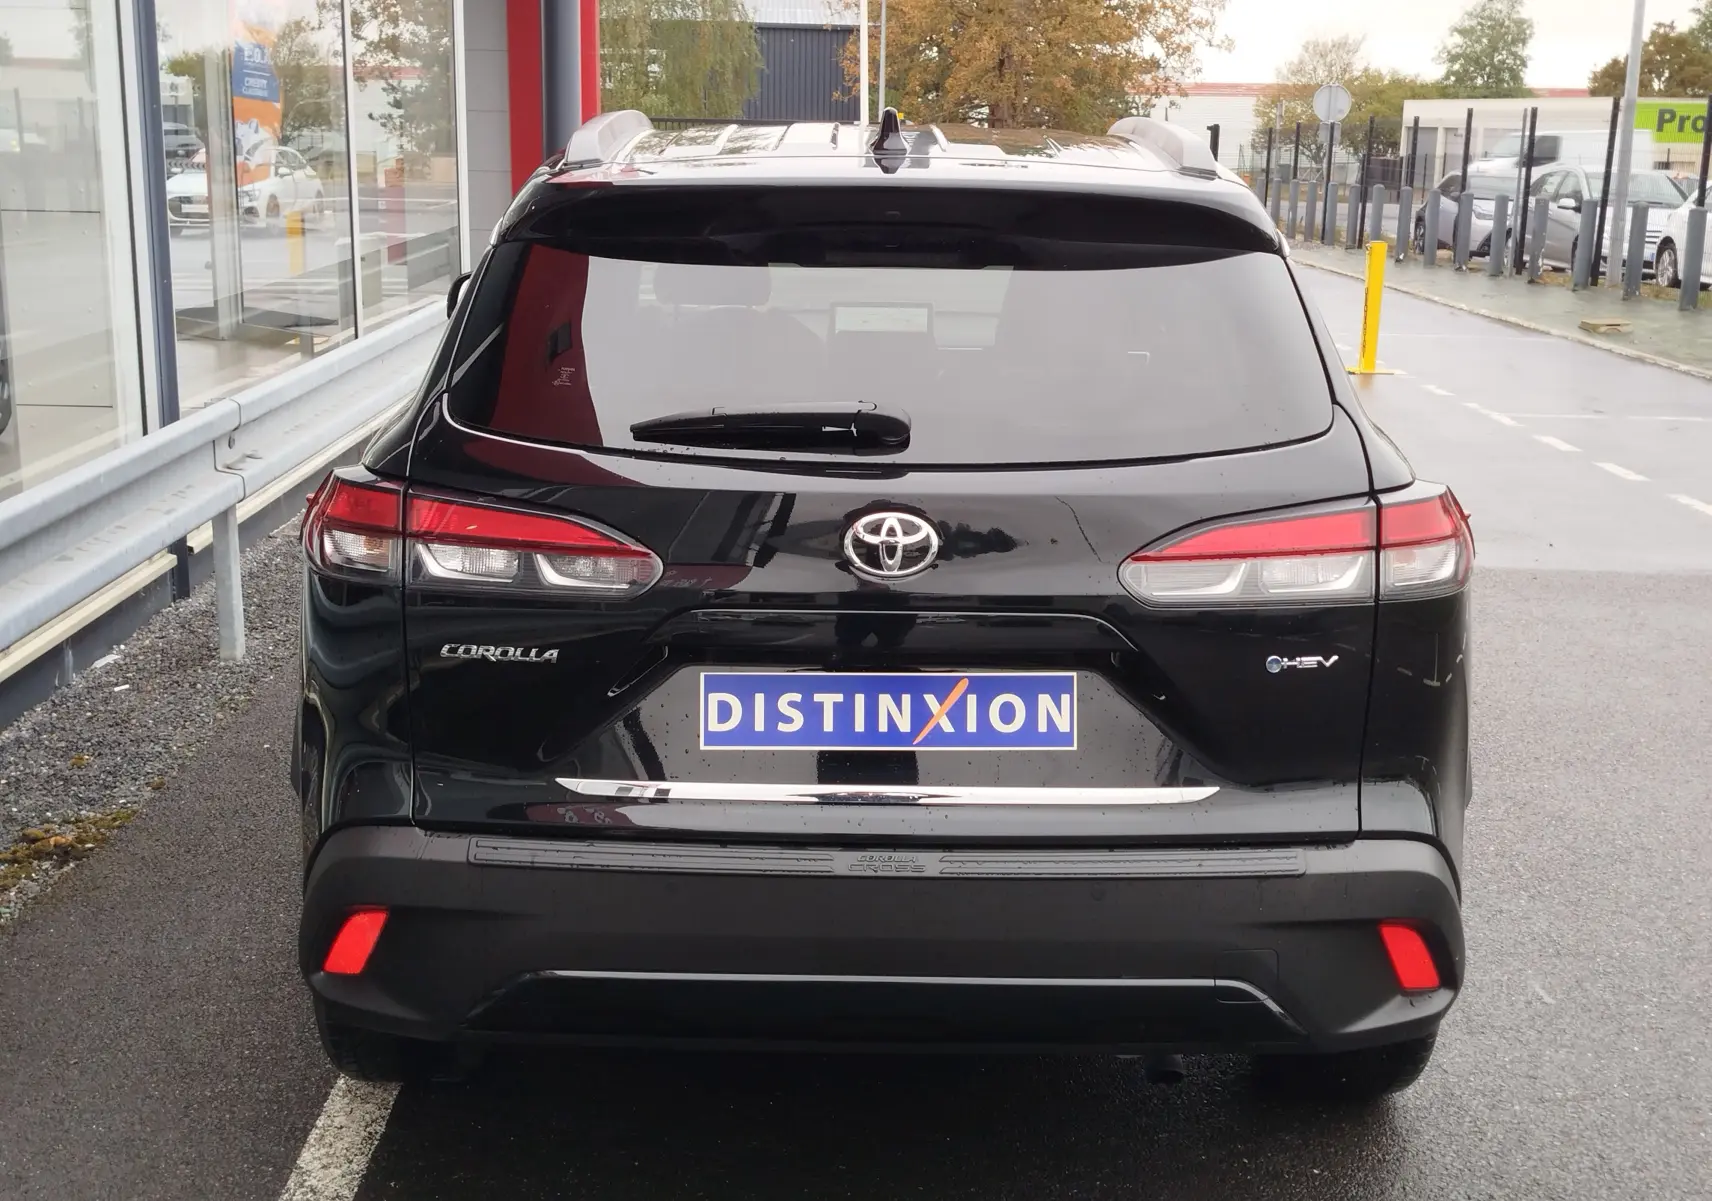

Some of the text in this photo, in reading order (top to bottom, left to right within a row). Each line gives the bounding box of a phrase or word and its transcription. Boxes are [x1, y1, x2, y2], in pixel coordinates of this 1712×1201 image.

[1656, 108, 1707, 133] Pro
[440, 643, 560, 663] COROLLA
[1281, 655, 1339, 669] HEV
[707, 677, 1071, 745] DISTINXION
[857, 855, 917, 863] COROLLA
[848, 863, 927, 873] CROSS
